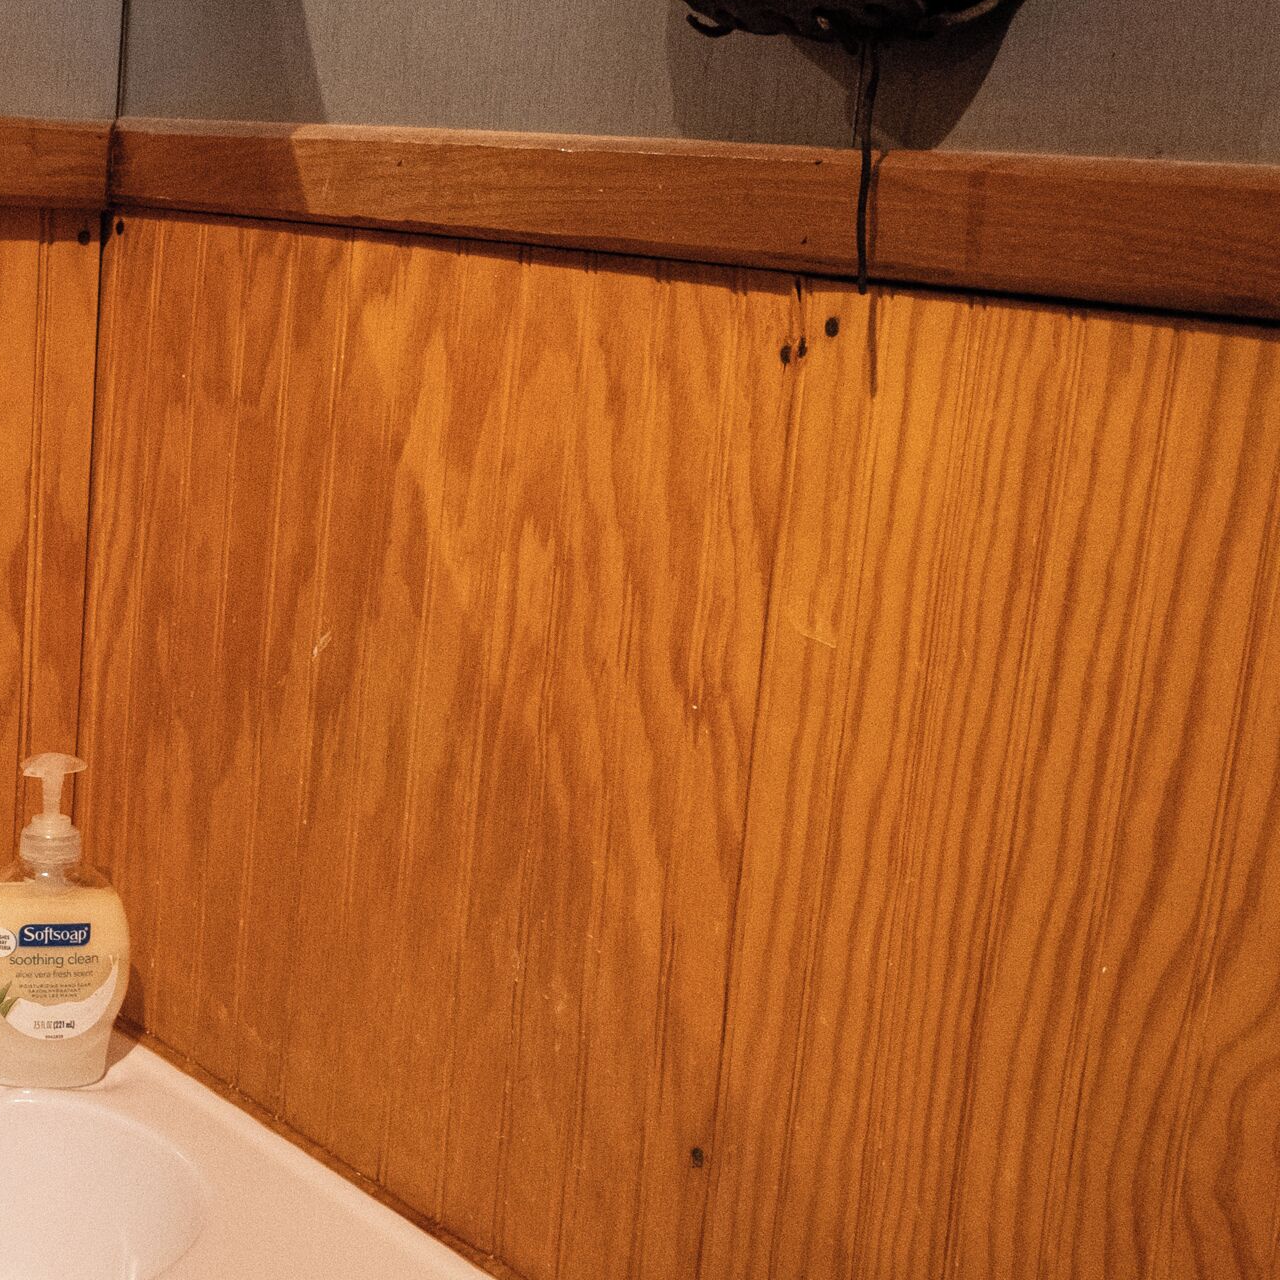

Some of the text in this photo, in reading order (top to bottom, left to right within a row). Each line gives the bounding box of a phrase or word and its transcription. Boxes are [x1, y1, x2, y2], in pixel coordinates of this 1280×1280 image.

[23, 926, 88, 944] Softsoap
[9, 952, 99, 968] soothing clean
